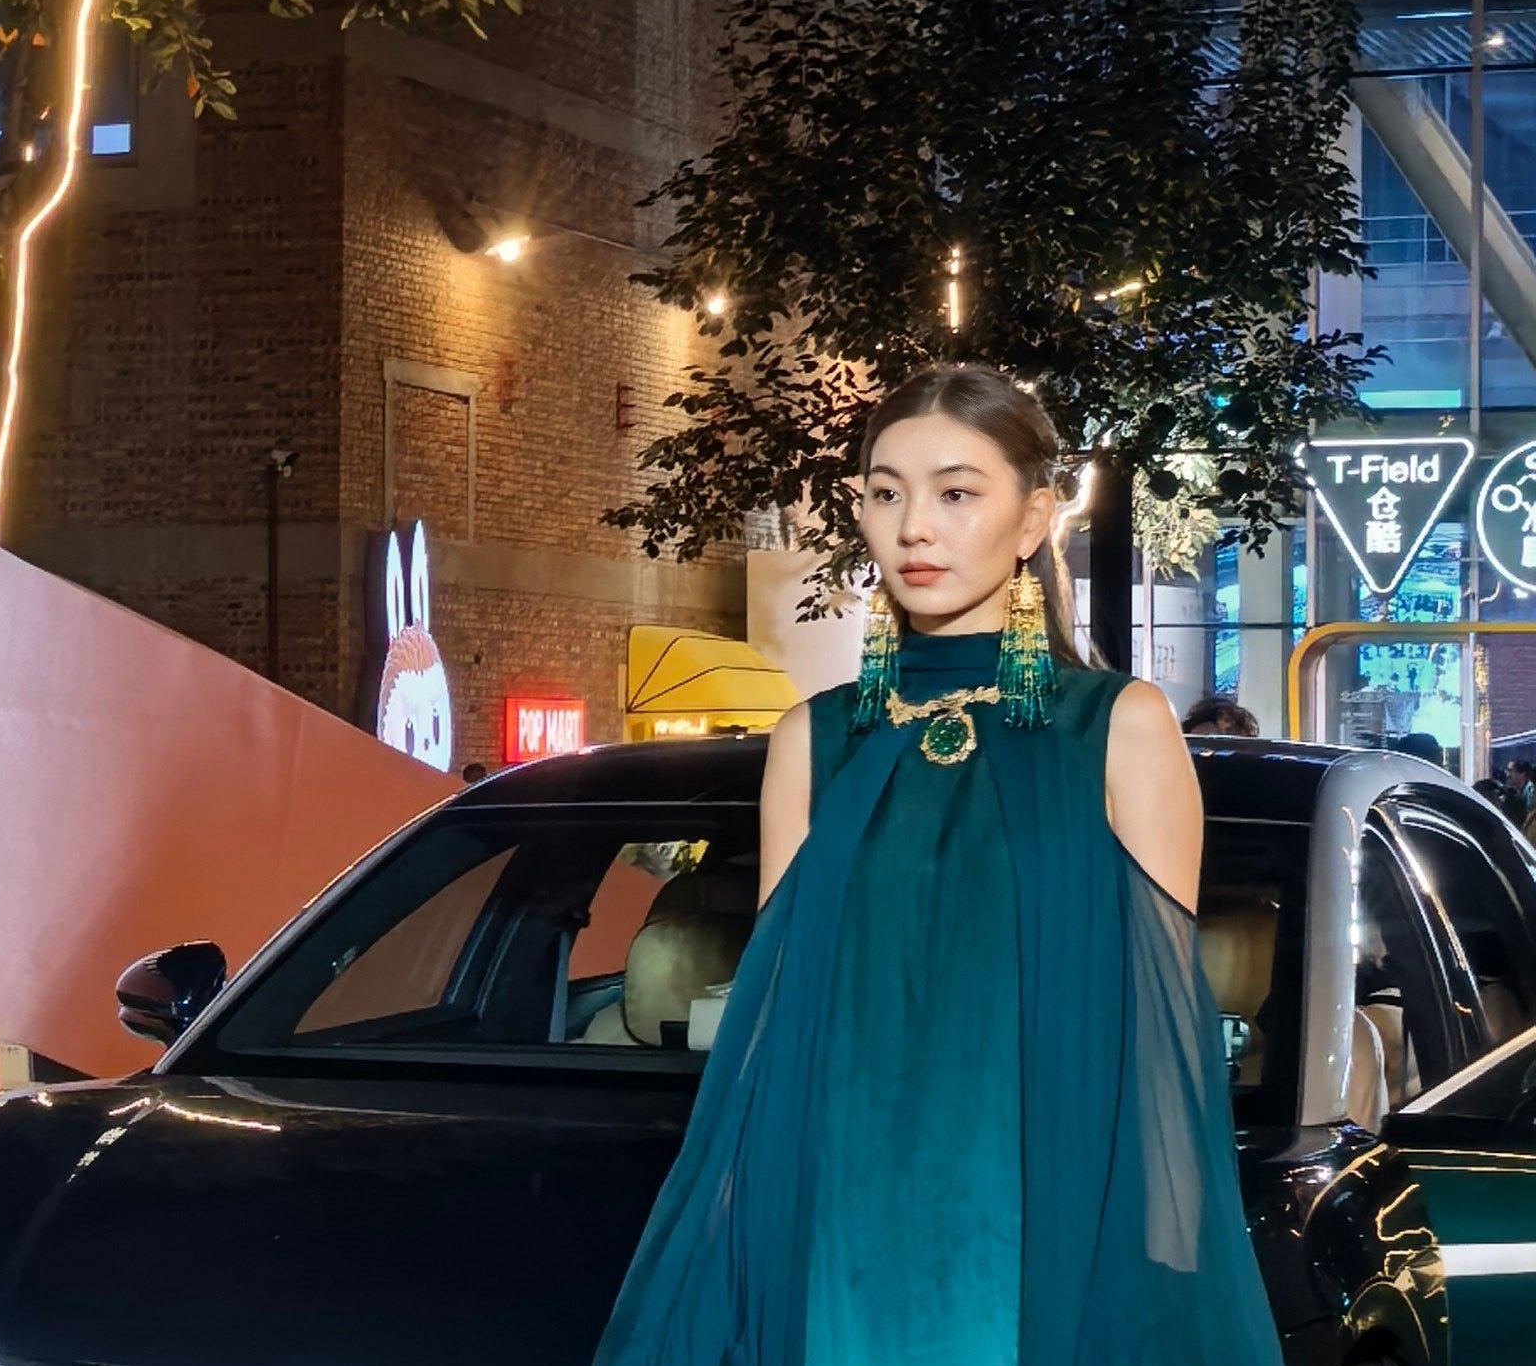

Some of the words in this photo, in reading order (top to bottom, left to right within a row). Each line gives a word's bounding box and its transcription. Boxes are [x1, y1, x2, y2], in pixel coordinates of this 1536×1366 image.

[1326, 453, 1440, 484] T-Field
[518, 708, 544, 753] POP
[545, 709, 581, 755] MART
